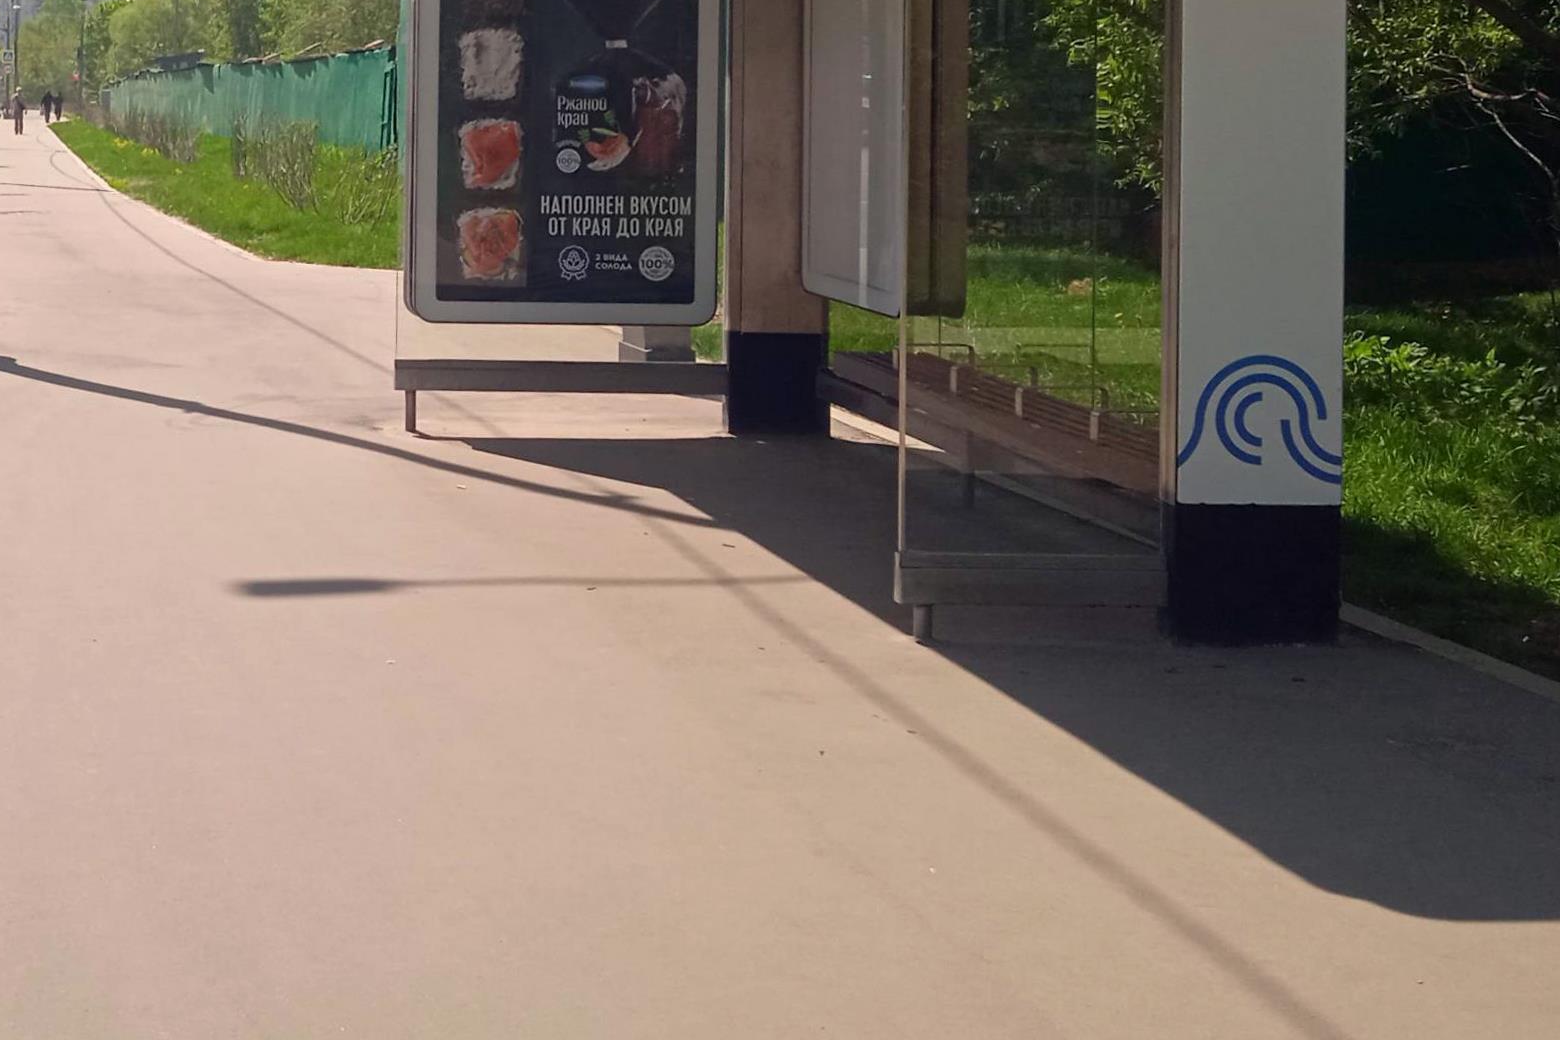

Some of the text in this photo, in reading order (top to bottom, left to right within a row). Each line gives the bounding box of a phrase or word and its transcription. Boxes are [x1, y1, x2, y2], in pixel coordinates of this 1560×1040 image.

[557, 95, 608, 111] Ржаной
[540, 195, 692, 216] НАПОЛНЕН ВКУСОМ
[548, 217, 684, 239] ОТ КРАЯ ДО КРАЯ
[595, 262, 633, 271] СОЛОДА
